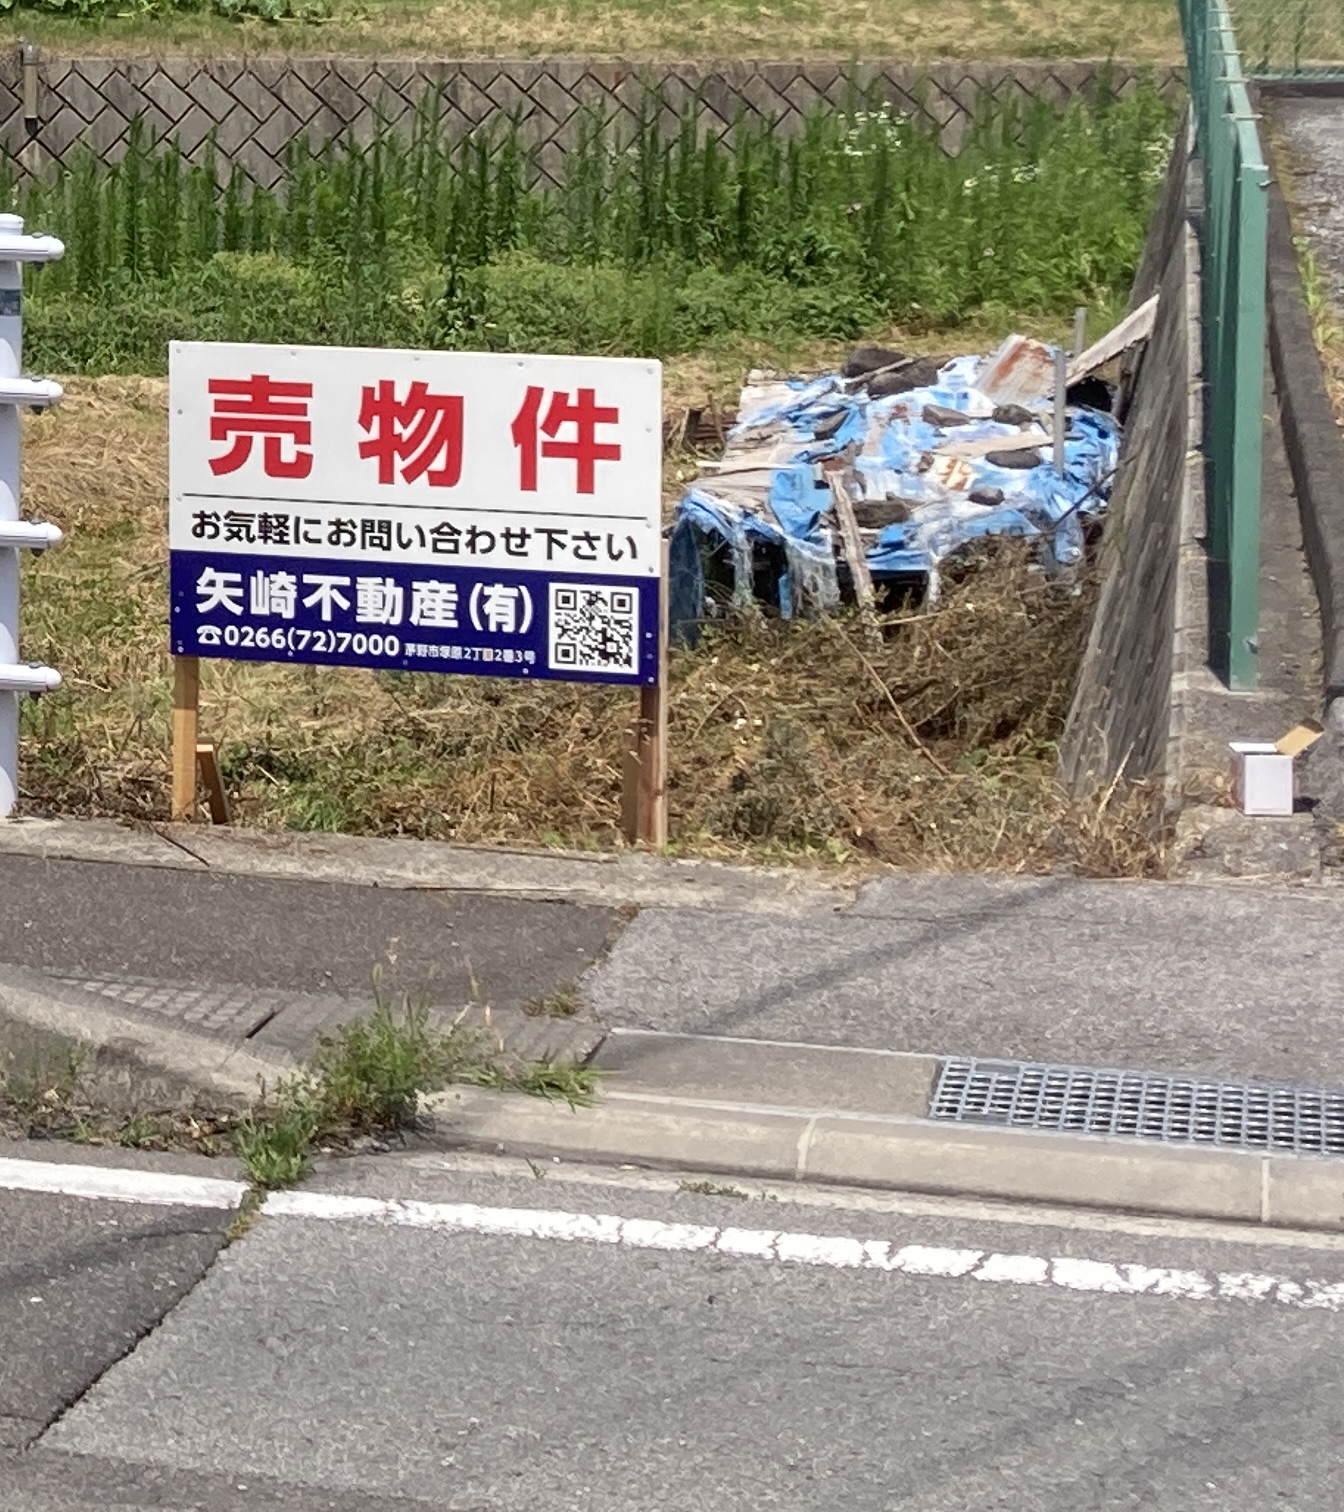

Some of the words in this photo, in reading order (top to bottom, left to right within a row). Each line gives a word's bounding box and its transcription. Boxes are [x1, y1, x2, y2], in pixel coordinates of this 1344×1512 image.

[207, 374, 621, 494] 売物件
[191, 510, 638, 562] お気軽にお問い合わせ下さい
[224, 624, 400, 657] 0266(72)7000
